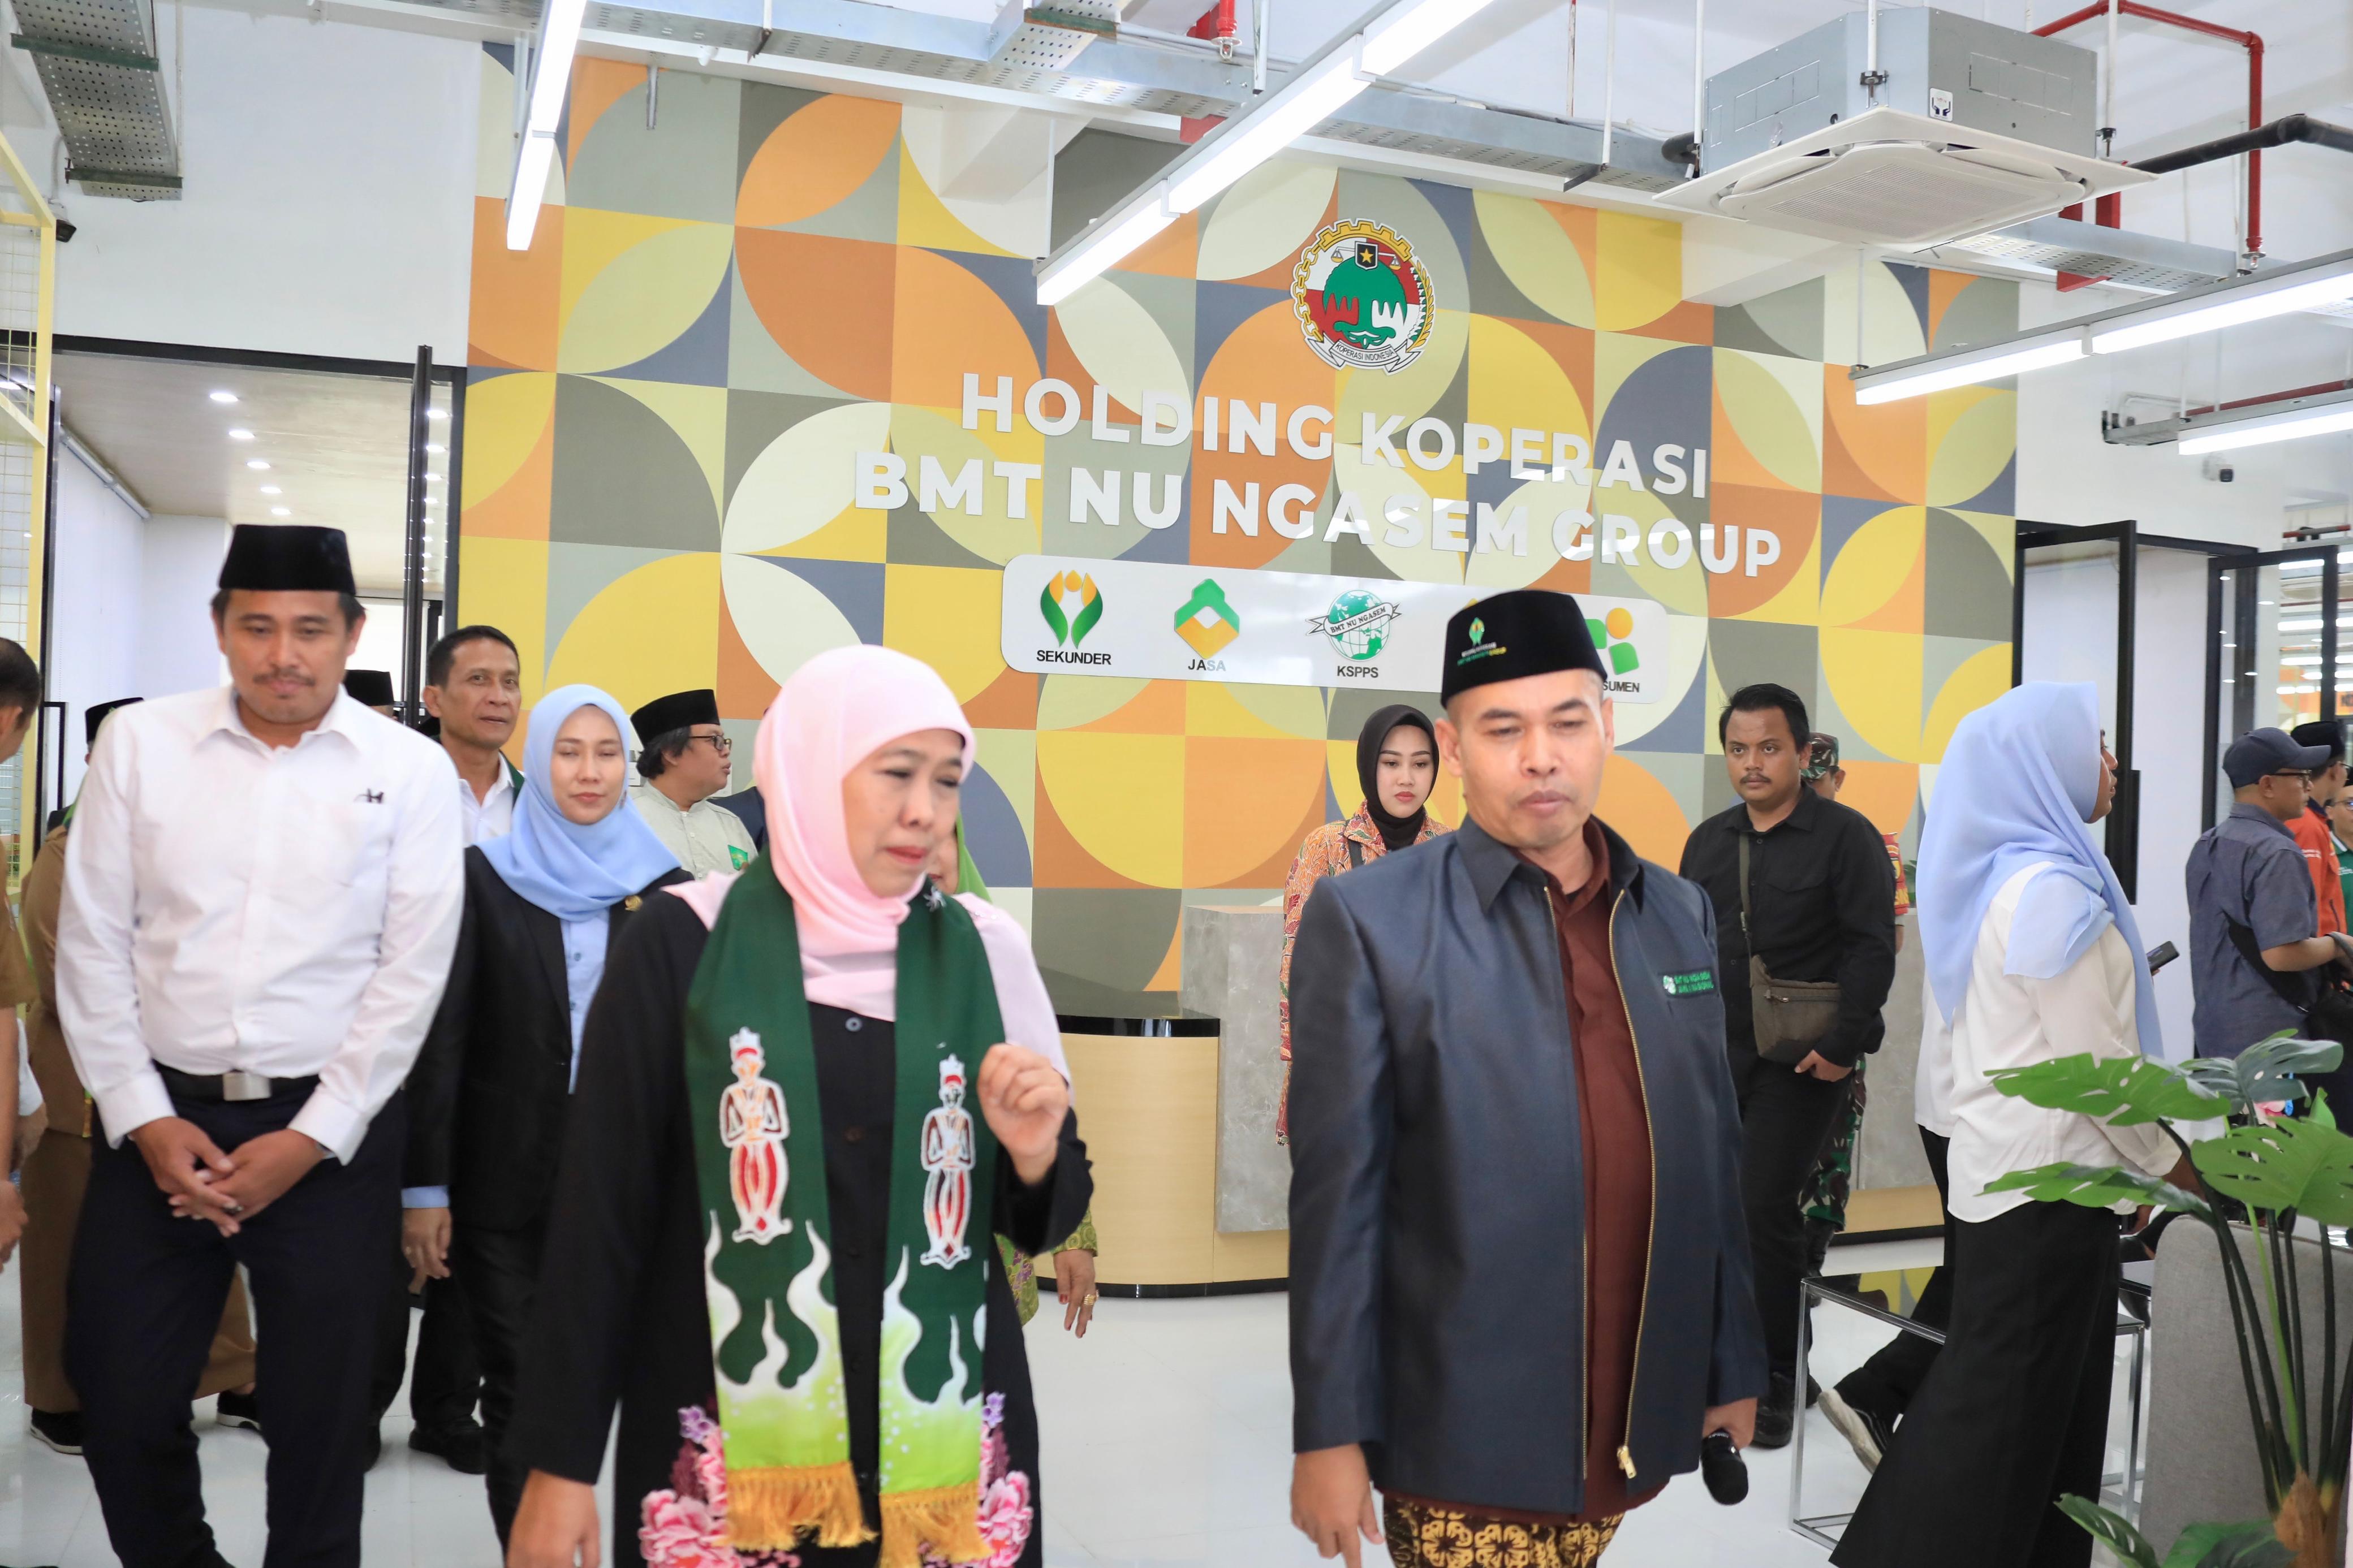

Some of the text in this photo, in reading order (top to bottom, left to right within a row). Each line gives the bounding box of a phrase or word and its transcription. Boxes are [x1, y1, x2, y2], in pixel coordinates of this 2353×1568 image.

[1335, 343, 1395, 361] KOPERASI INDONESIA
[963, 372, 1707, 499] HOLDING KOPERASI
[855, 452, 1782, 578] BMT NU NGASEM GROUP
[1330, 624, 1344, 633] BMT
[1359, 606, 1386, 624] NGASEM
[1036, 650, 1111, 665] SEKUNDER
[1188, 659, 1226, 672] JASA
[1337, 666, 1378, 678] KSPPS
[1603, 681, 1640, 693] SUMEN
